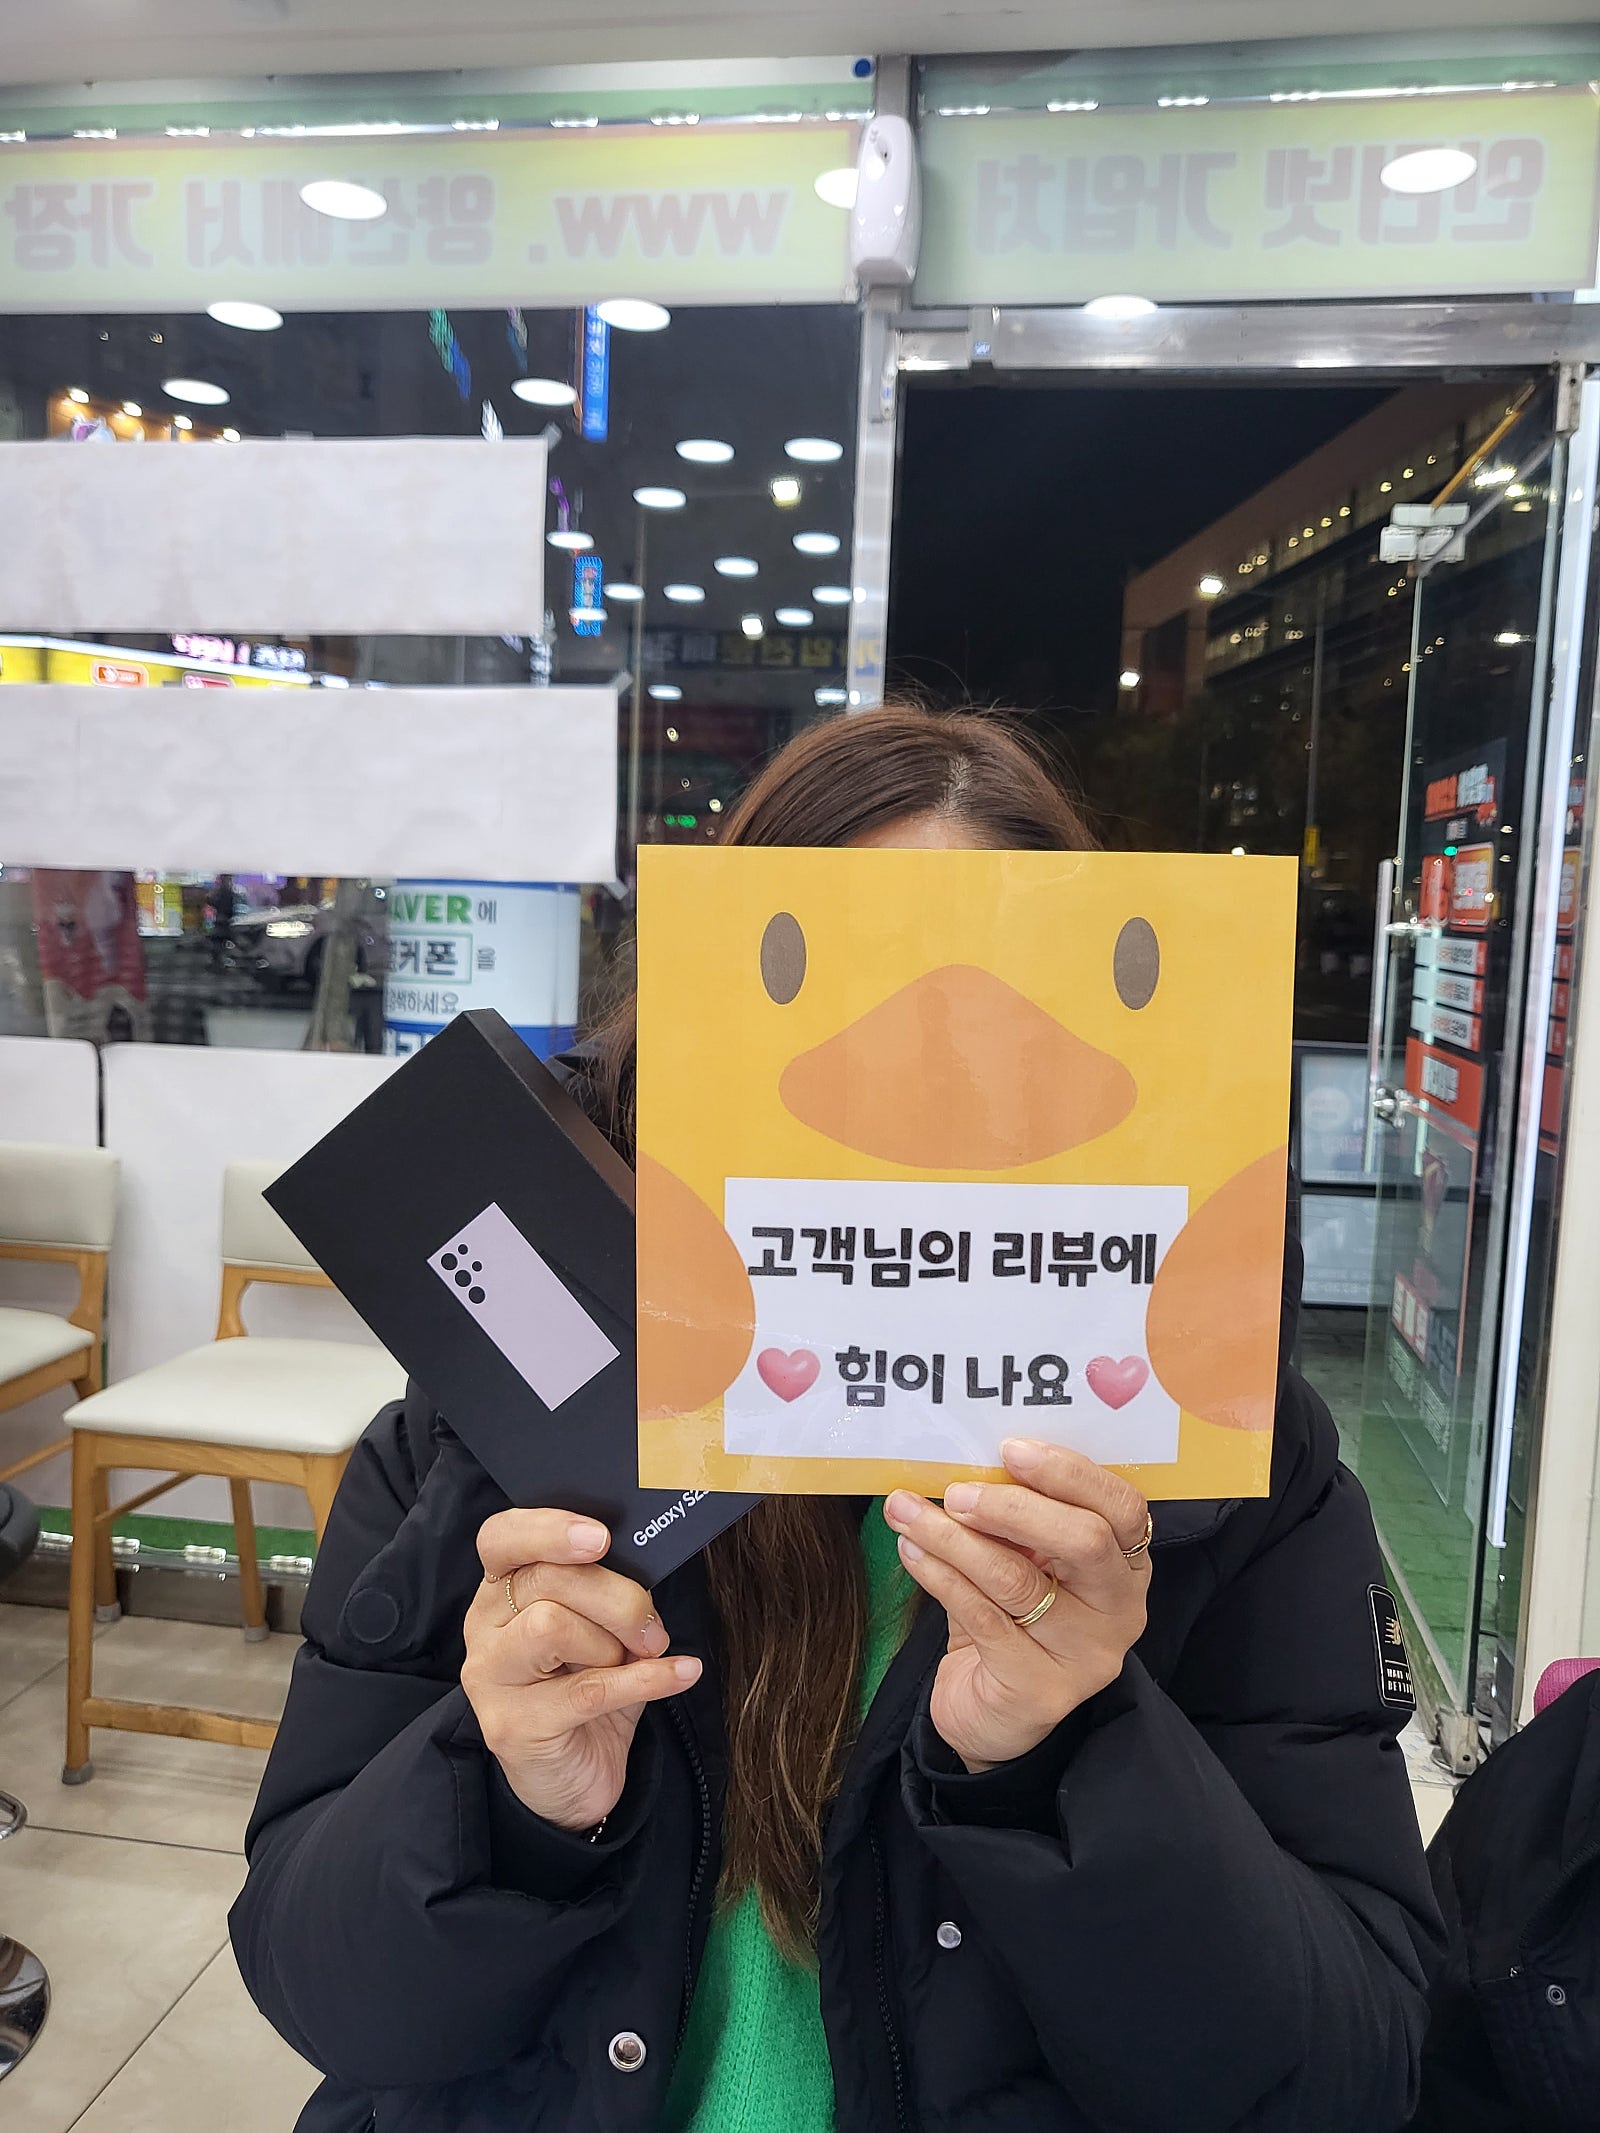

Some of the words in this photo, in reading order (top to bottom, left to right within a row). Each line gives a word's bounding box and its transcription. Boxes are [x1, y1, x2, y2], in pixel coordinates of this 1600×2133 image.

[390, 894, 472, 923] AVER
[478, 900, 497, 924] 에
[477, 947, 496, 971] 을
[748, 1226, 971, 1288] 고객님의
[992, 1231, 1157, 1288] 리뷰에
[835, 1345, 945, 1408] 힘이
[966, 1353, 1073, 1407] 나요
[633, 1500, 687, 1547] Galaxy
[682, 1490, 710, 1507] S2
